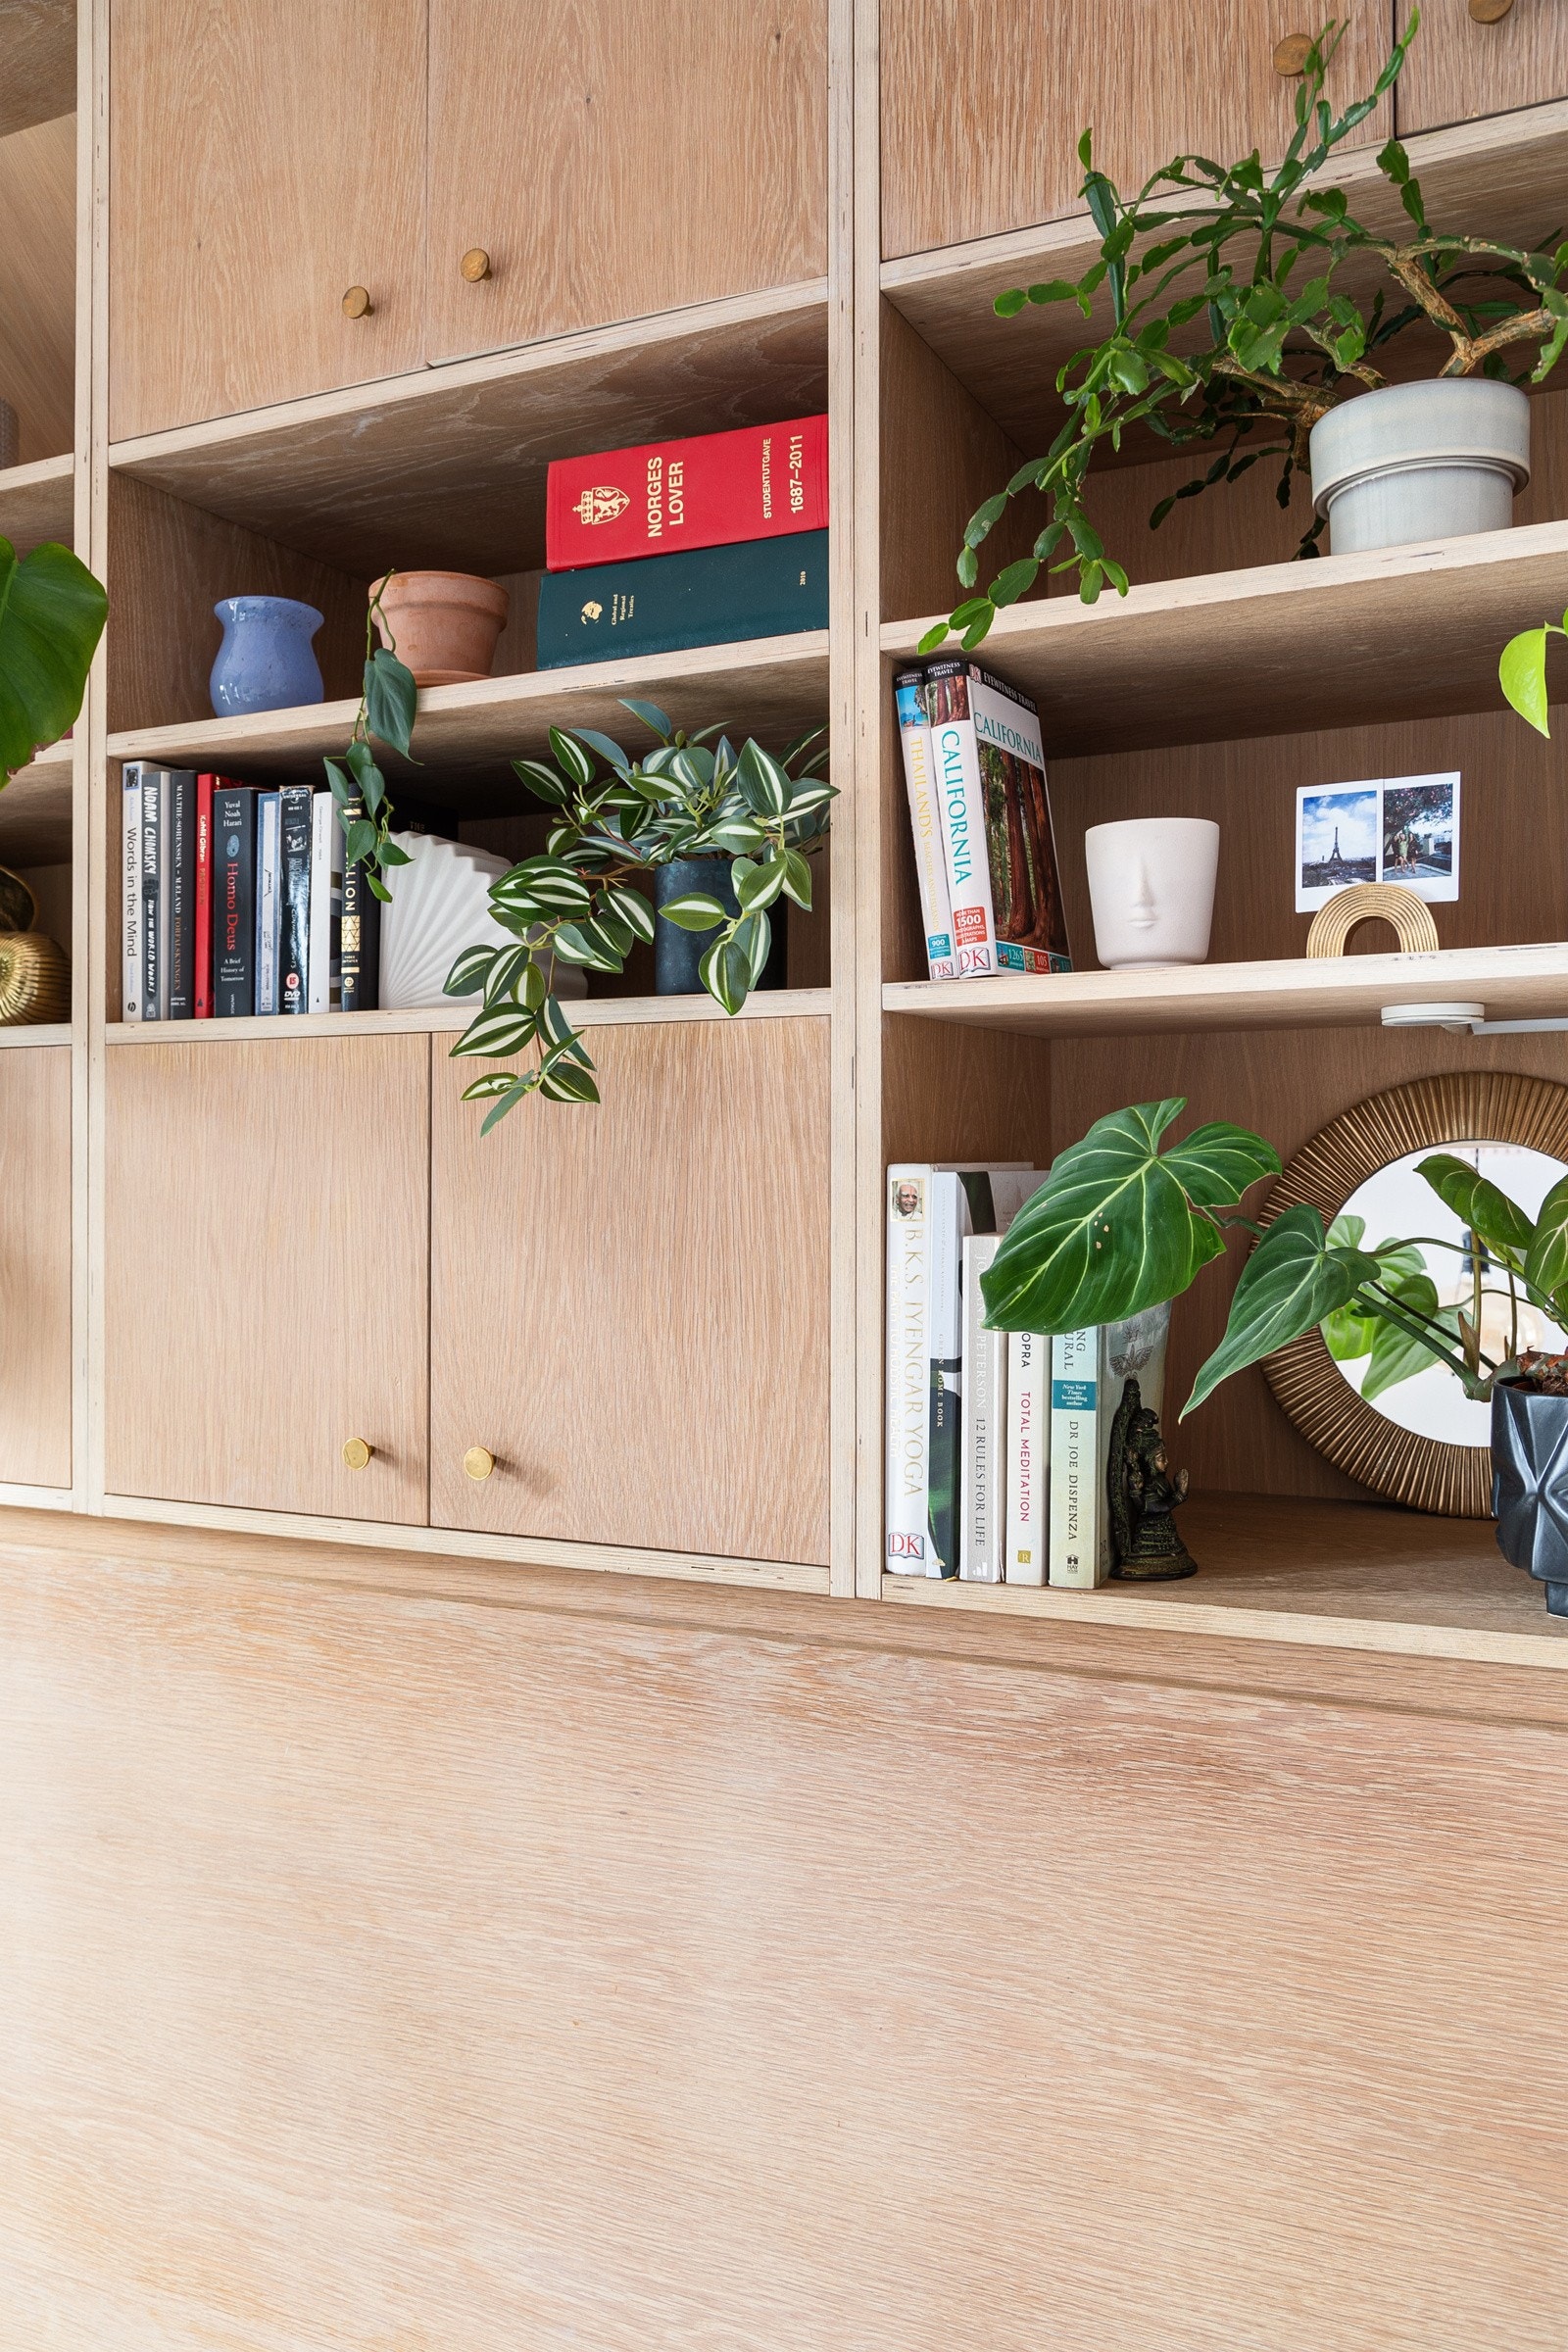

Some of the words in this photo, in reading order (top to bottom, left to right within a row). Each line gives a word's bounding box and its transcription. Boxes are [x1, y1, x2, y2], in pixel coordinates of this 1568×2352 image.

[668, 461, 684, 526] LOVER
[762, 438, 771, 519] STUDENTUTGAVE
[647, 456, 662, 538] NORGES
[927, 662, 960, 674] EYEWITNESS
[934, 668, 954, 677] TRAVEL
[983, 671, 1018, 701] EYEWITNESS
[1018, 692, 1037, 713] TRAVEL
[974, 712, 1042, 763] CALIFORNIA
[144, 786, 158, 822] NOAM
[224, 800, 241, 808] Yuval
[909, 737, 933, 839] THAILAND'S
[223, 818, 242, 827] Harari
[224, 808, 241, 817] Noah
[942, 730, 972, 885] CALIFORNIA
[127, 827, 137, 871] Words
[144, 826, 157, 874] CHOMSKY
[127, 876, 137, 888] in
[226, 861, 238, 910] Homo
[127, 893, 137, 916] the
[956, 913, 982, 928] 1500
[127, 920, 137, 957] Mind
[226, 913, 238, 951] Deus
[932, 938, 946, 948] 900
[932, 961, 951, 976] DK
[959, 949, 987, 971] DK
[1008, 948, 1023, 961] 1265
[1037, 955, 1048, 967] 105
[284, 990, 301, 999] DVD
[905, 1301, 923, 1415] IYENGAR
[1021, 1333, 1031, 1368] OPRA
[976, 1336, 987, 1408] PETERSON
[975, 1418, 986, 1431] 12
[1020, 1392, 1031, 1434] TOTAL
[1068, 1421, 1078, 1439] DR
[905, 1424, 923, 1497] YOGA
[975, 1437, 986, 1479] RULES
[1068, 1446, 1078, 1468] JOE
[975, 1484, 986, 1511] FOR
[1020, 1439, 1030, 1522] MEDITATION
[1068, 1475, 1078, 1541] DISPENZA
[891, 1534, 921, 1556] DK
[975, 1517, 986, 1546] LIFE
